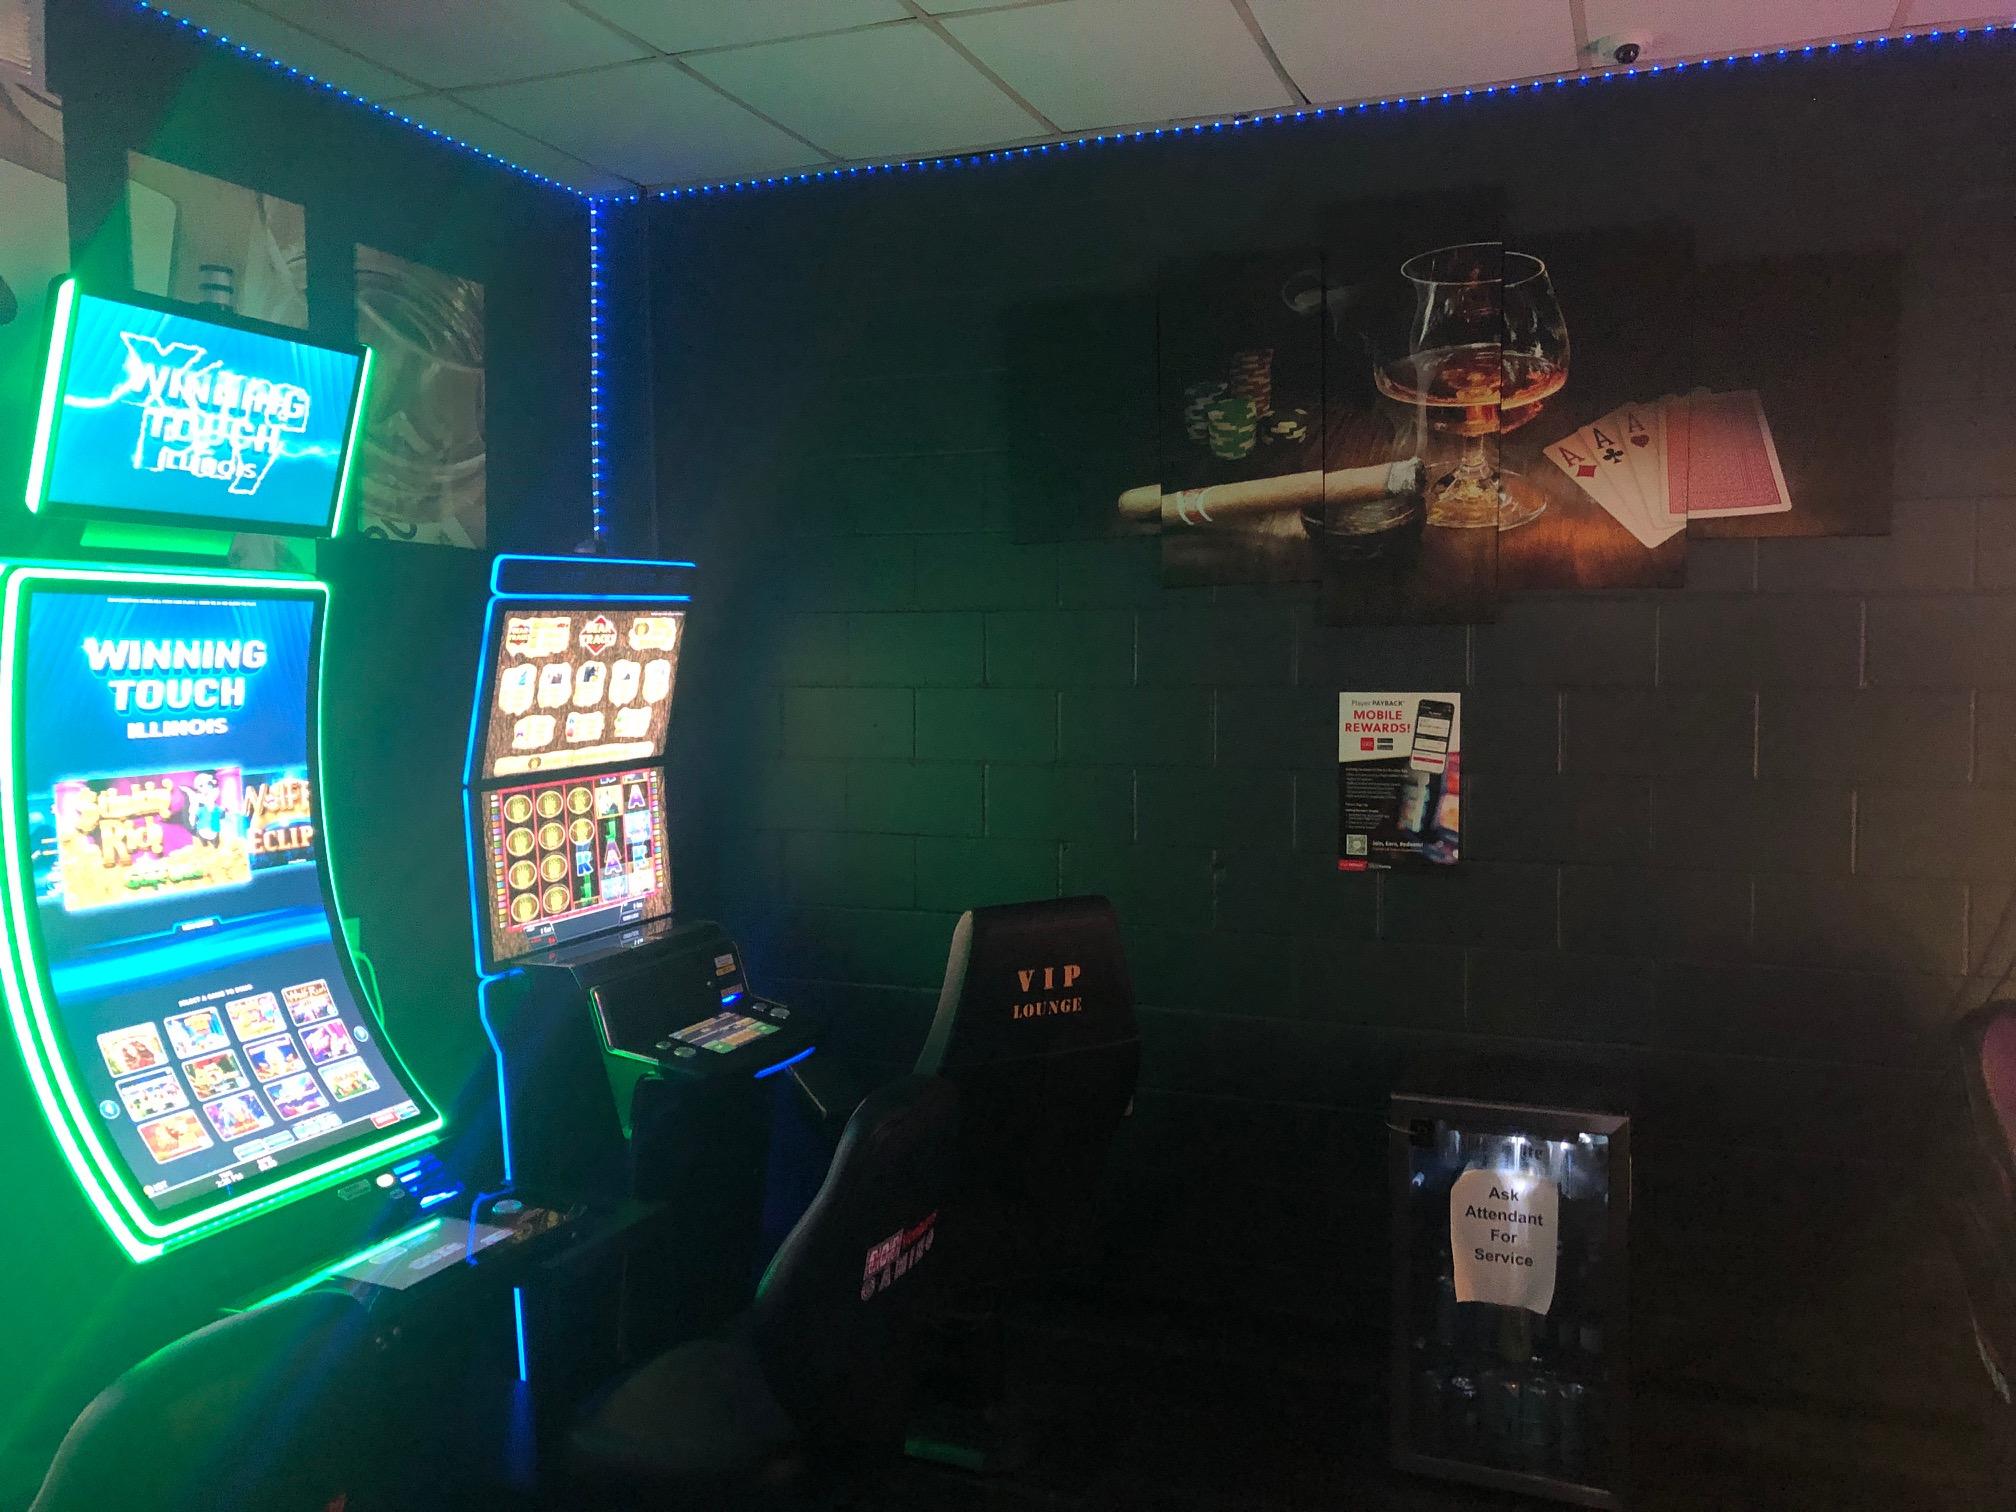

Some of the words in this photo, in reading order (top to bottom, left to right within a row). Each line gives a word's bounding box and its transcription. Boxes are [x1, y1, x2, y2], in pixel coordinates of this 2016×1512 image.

[1628, 412, 1646, 433] A
[1593, 428, 1615, 449] A
[1558, 447, 1585, 467] A
[83, 637, 267, 671] WINNING
[108, 677, 245, 711] TOUCH
[1353, 710, 1402, 720] MOBILE
[127, 717, 229, 739] ILLINOIS
[1345, 723, 1411, 733] REWARDS!
[1017, 963, 1082, 993] VIP
[1012, 997, 1083, 1020] LOUNGE
[1489, 1186, 1519, 1201] Ask
[1465, 1205, 1544, 1227] Attendant
[1490, 1229, 1518, 1243] For
[1474, 1248, 1534, 1267] Service
